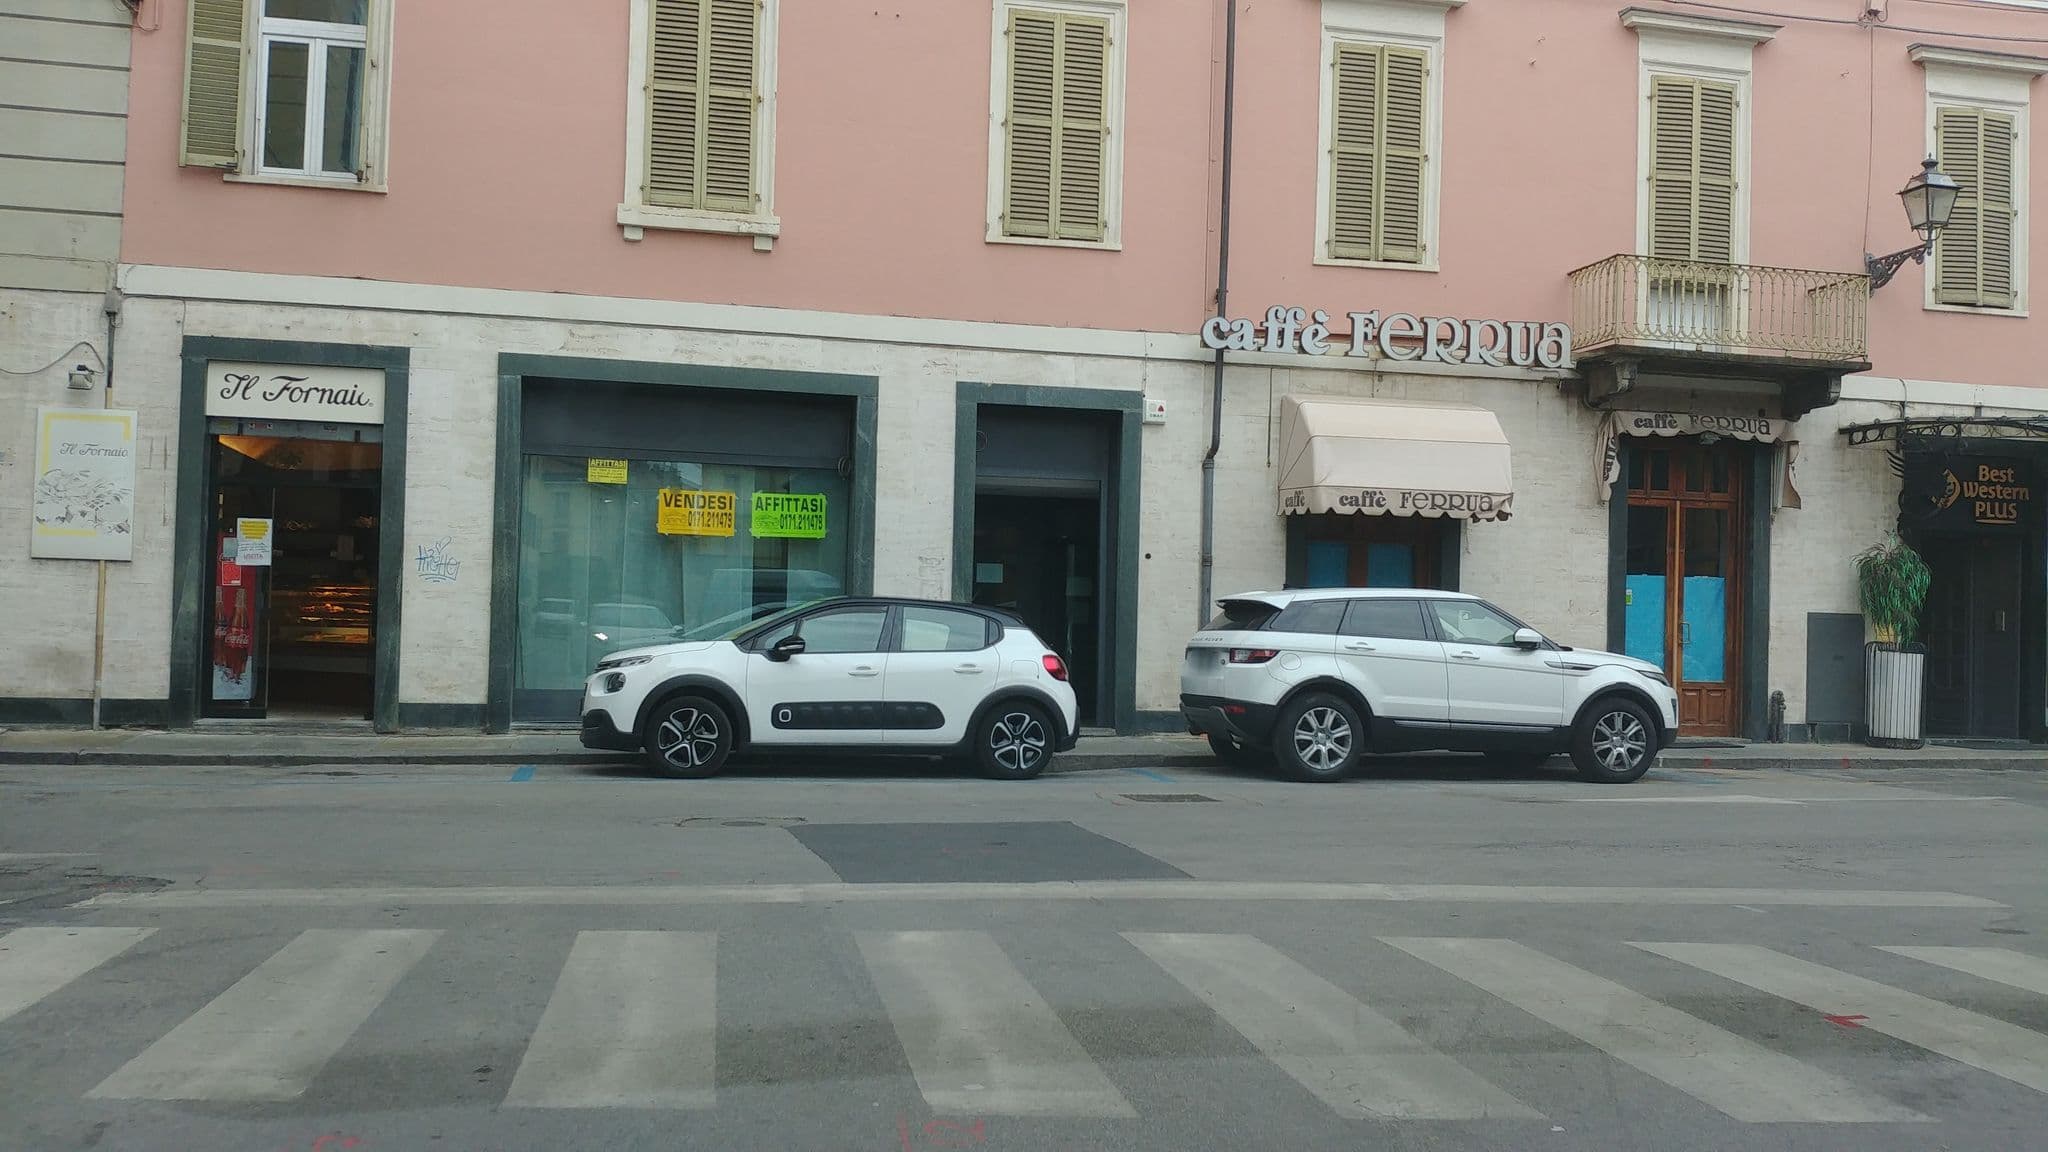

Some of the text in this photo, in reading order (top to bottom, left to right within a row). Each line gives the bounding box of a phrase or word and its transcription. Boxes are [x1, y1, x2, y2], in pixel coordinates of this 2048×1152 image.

[1201, 304, 1331, 355] caffè
[220, 373, 260, 400] Il
[1634, 414, 1678, 429] caffè
[60, 442, 128, 457] Il Fornaio
[590, 458, 626, 468] AFFITTASI
[1978, 465, 2015, 482] Best
[1338, 490, 1387, 507] caffè
[1963, 481, 2030, 500] Western
[663, 493, 733, 510] VENDESI
[755, 496, 823, 512] AFFITTASI
[1975, 501, 2017, 519] PLUS
